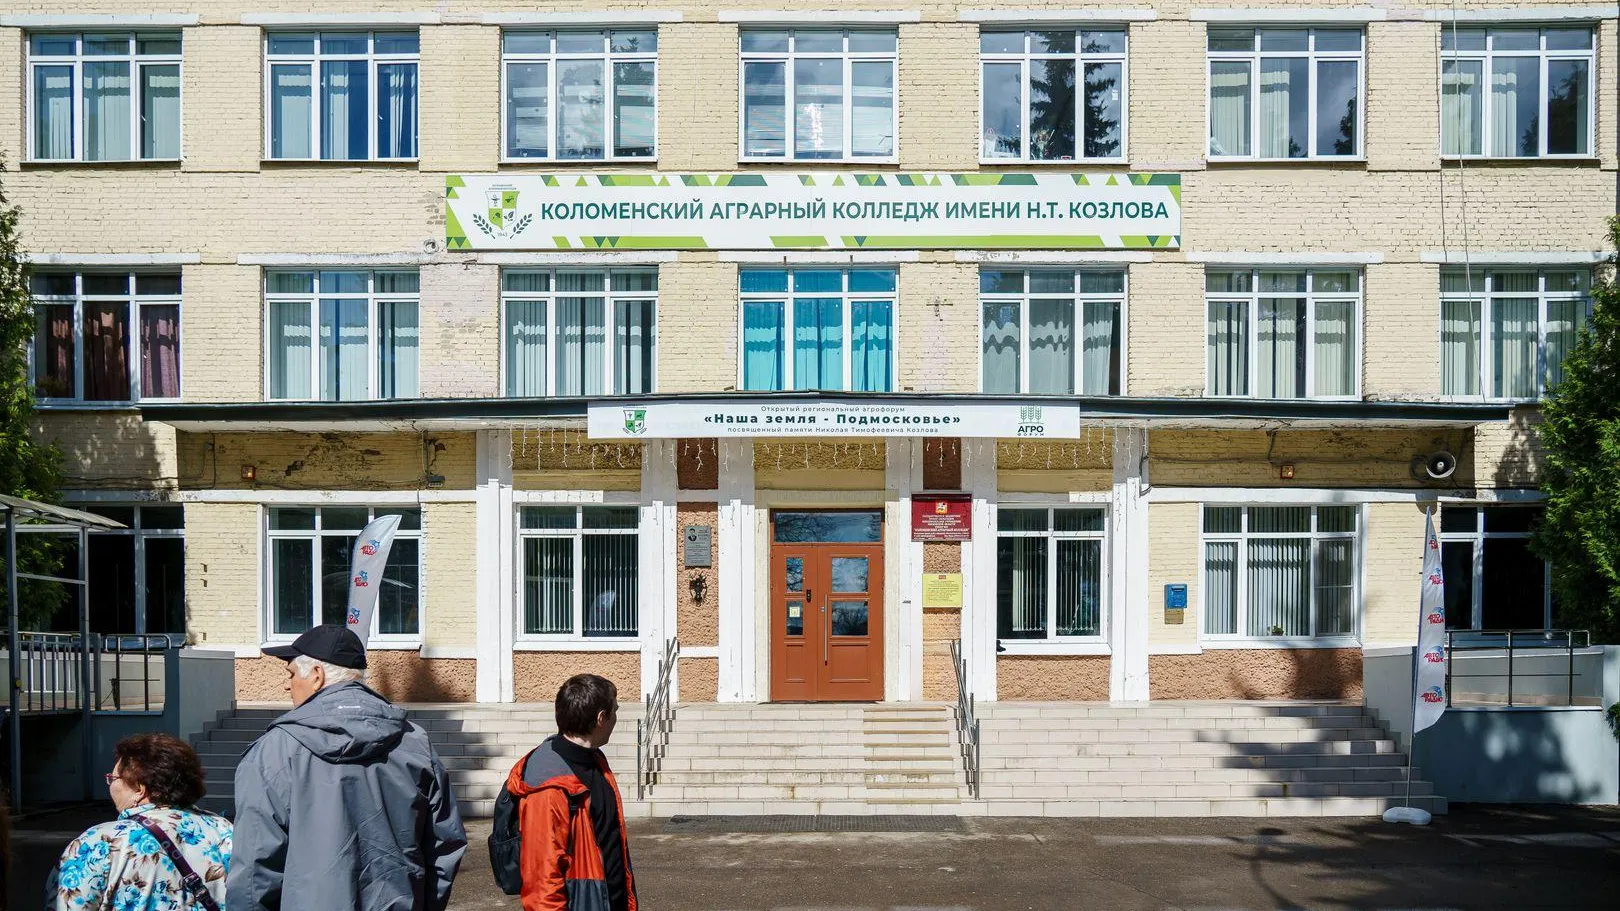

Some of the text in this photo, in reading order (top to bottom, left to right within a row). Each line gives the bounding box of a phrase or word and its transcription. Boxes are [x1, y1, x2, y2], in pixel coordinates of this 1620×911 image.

[541, 197, 1169, 222] КОЛОМЕНСКИЙ АГРАРНЫЙ КОЛЛЕДЖ ИМЕНИ Н.Т. КОЗЛОВА
[761, 405, 800, 413] Открытый
[803, 405, 859, 413] региональный
[704, 414, 758, 424] «Наша
[765, 415, 816, 424] земля
[836, 413, 961, 425] Подмосковье»
[1017, 425, 1044, 433] АГРО
